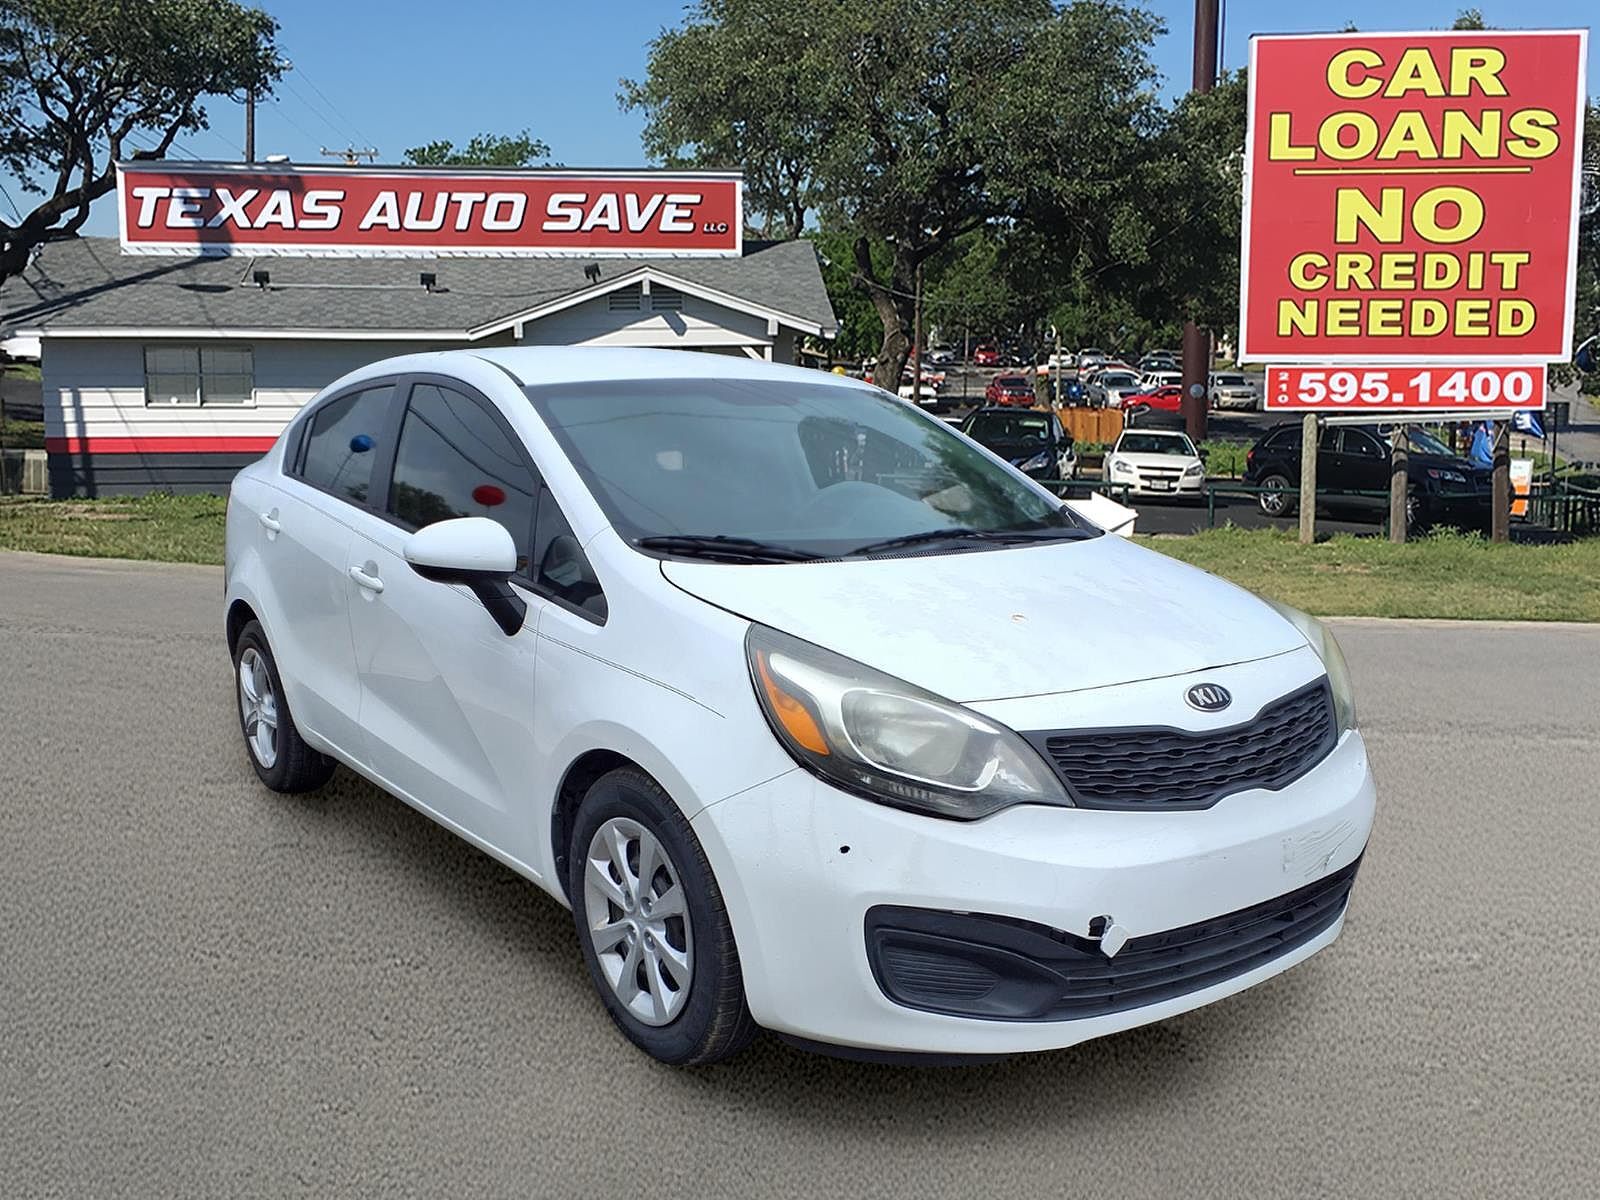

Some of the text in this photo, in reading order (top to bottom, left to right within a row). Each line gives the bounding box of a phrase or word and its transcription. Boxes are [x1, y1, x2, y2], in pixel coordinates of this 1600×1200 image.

[1326, 47, 1510, 99] CAR
[1268, 108, 1560, 161] LOANS
[132, 187, 728, 234] TEXAS AUTO SAVE LLC
[1334, 185, 1485, 244] NO
[1288, 251, 1530, 291] CREDIT
[1277, 299, 1537, 337] NEEDED
[1297, 371, 1534, 403] 595.1400
[1190, 686, 1230, 706] KIA
